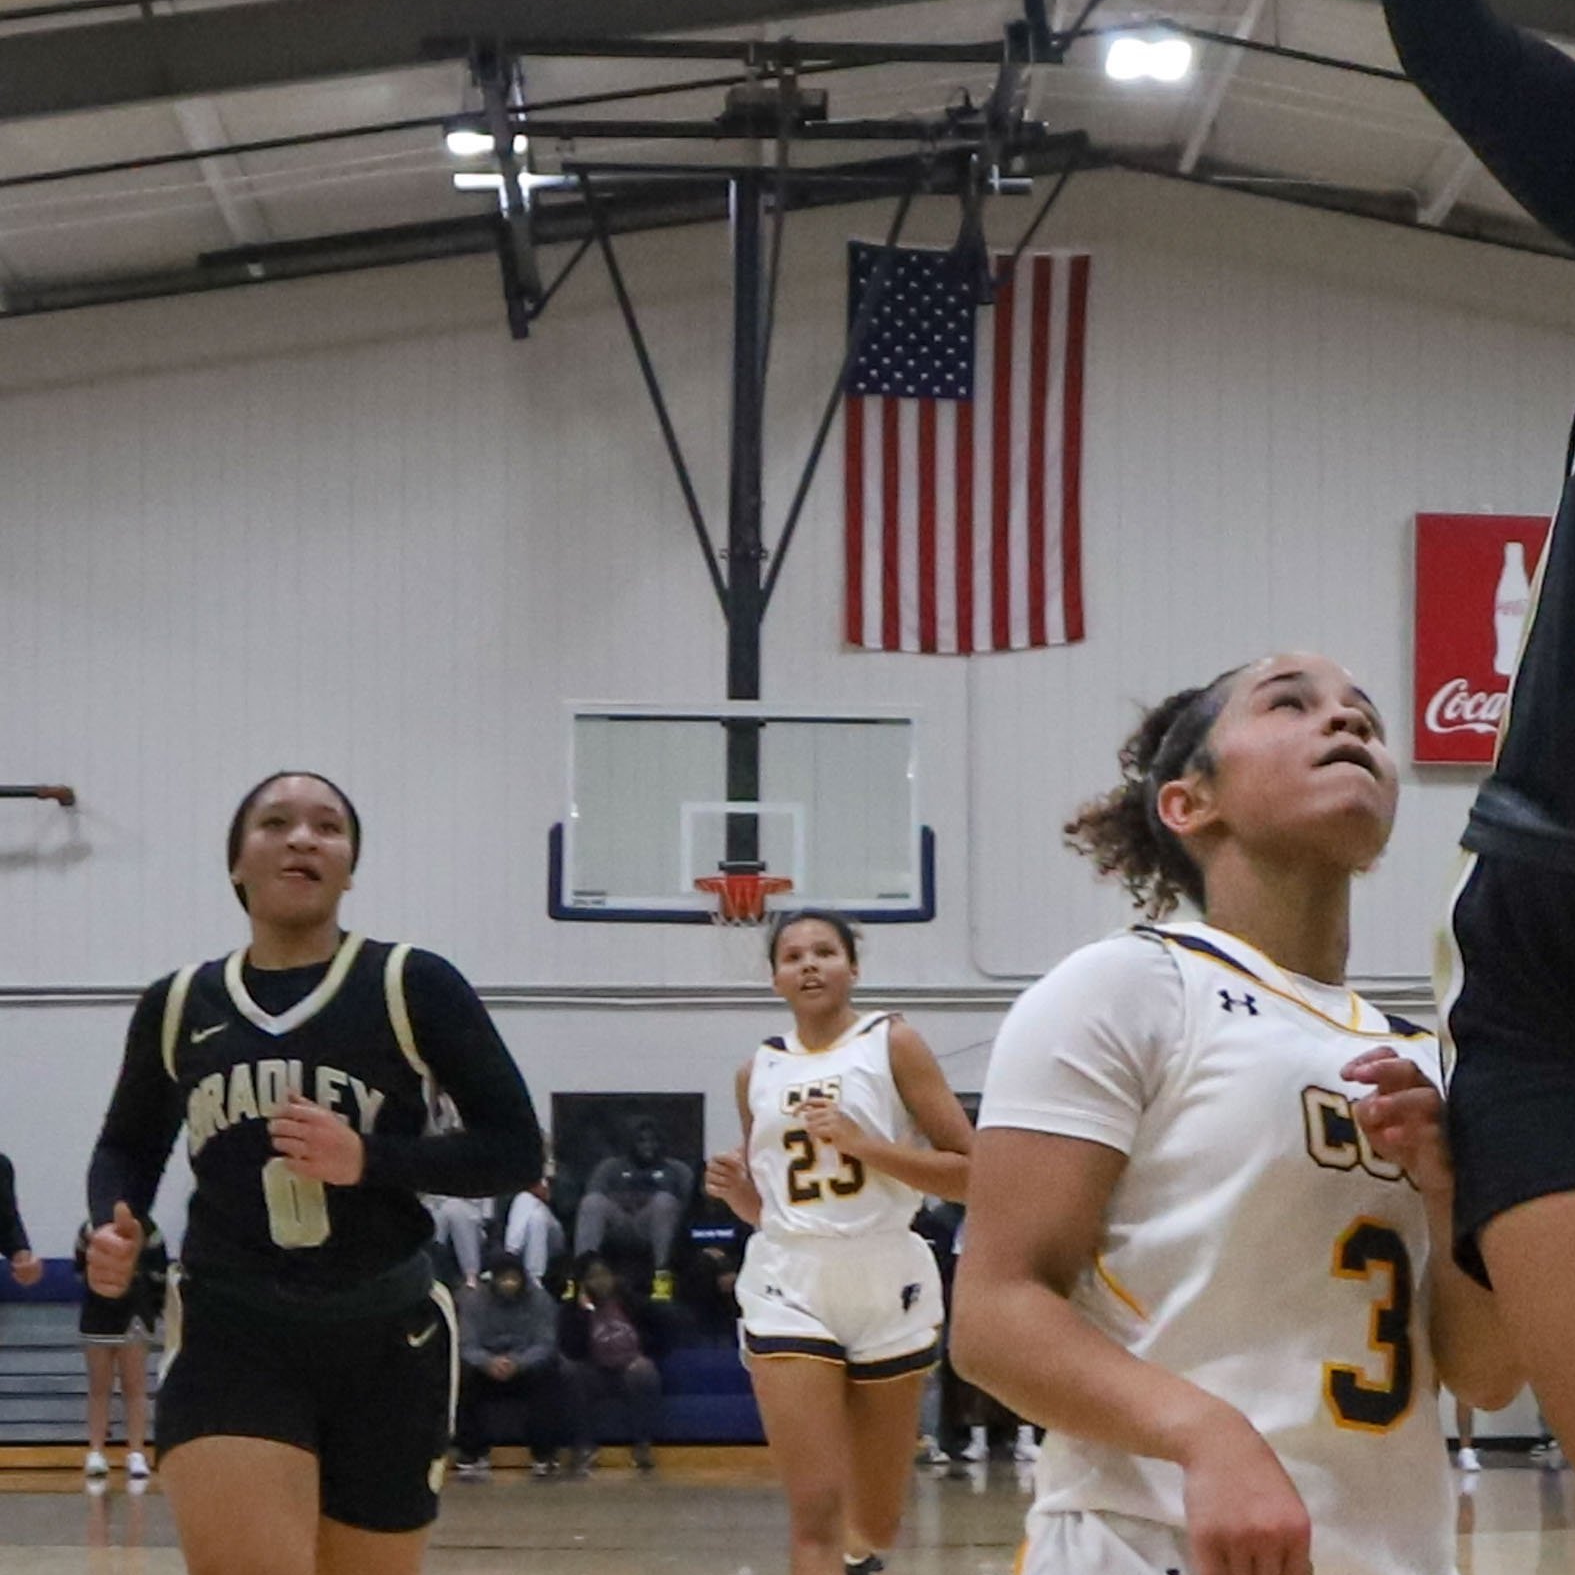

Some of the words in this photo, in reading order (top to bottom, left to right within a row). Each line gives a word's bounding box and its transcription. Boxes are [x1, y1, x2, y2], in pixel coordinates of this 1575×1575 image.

[1425, 679, 1508, 734] Coca
[262, 1156, 331, 1249] 0
[1322, 1215, 1414, 1434] 3
